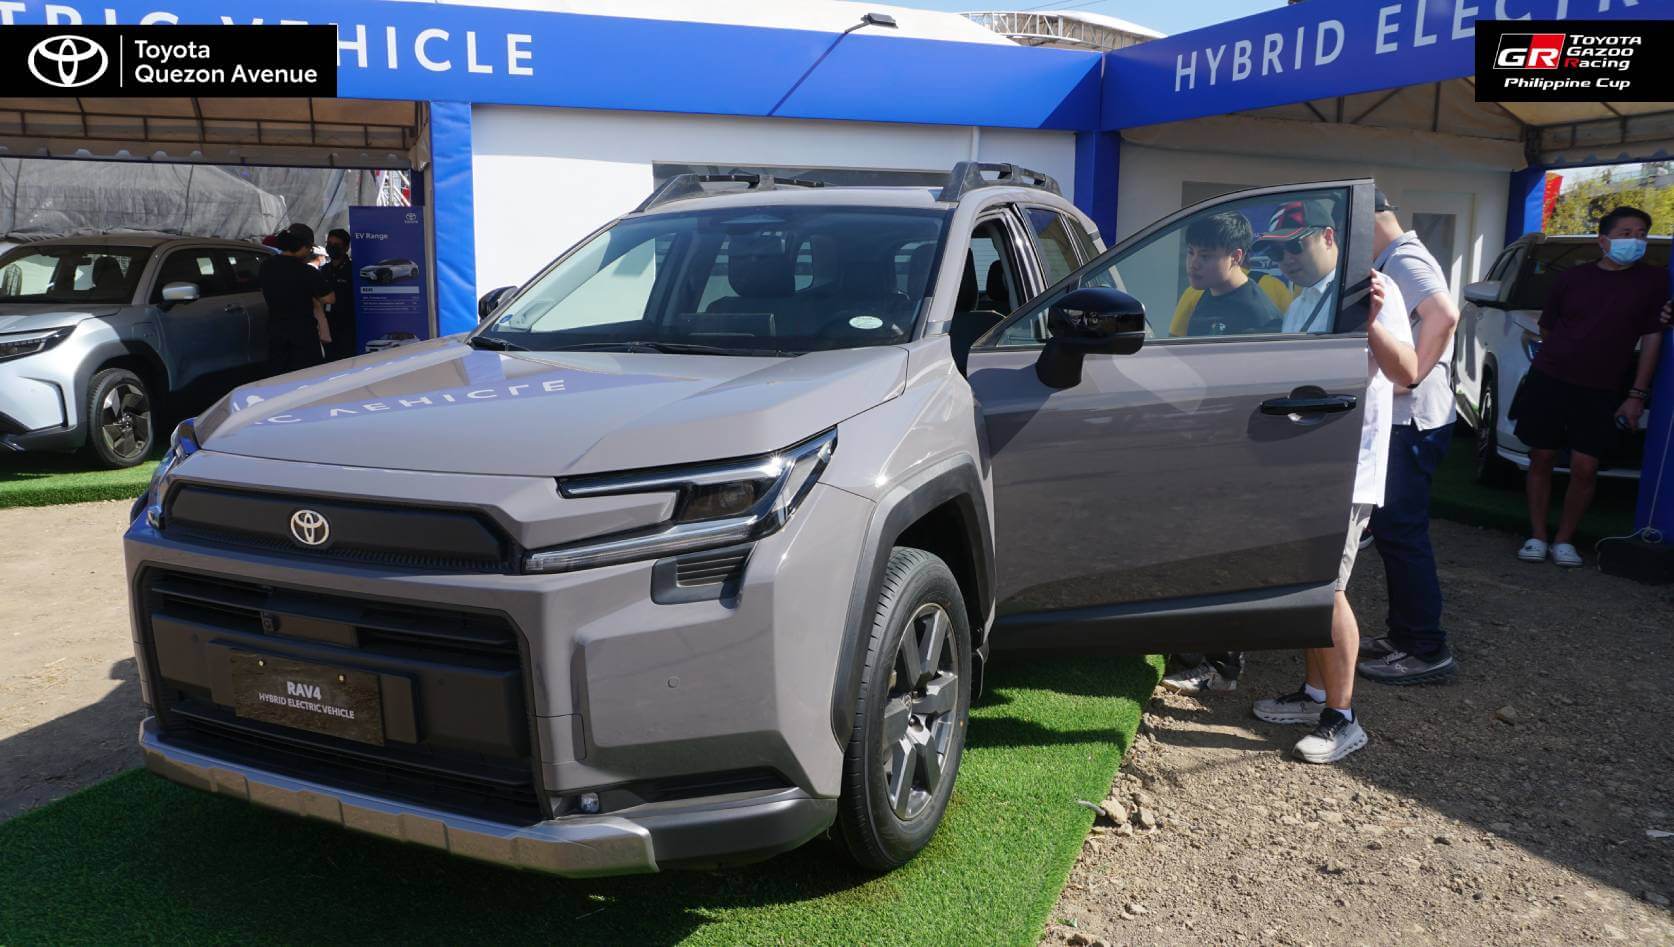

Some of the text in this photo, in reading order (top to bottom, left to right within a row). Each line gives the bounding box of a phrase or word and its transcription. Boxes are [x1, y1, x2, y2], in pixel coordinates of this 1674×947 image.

[1174, 19, 1345, 93] HYBRID
[355, 232, 389, 241] EV Range
[286, 680, 322, 701] RAV4
[258, 692, 355, 720] HYBRID ELECTRIC VEHICLE
